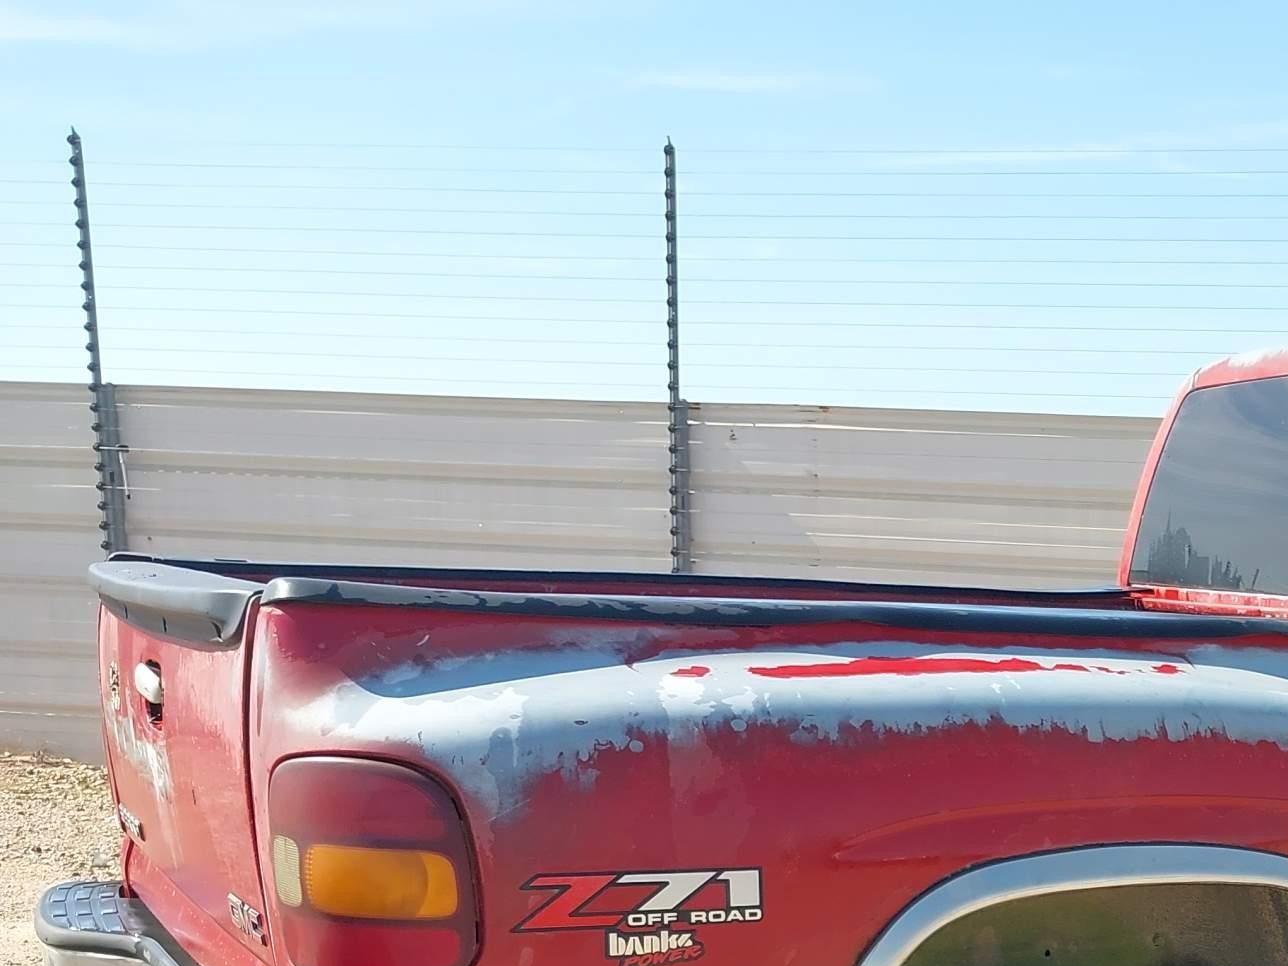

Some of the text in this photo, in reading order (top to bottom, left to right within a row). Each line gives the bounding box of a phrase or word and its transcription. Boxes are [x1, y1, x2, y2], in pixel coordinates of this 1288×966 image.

[227, 893, 267, 947] GMC
[512, 868, 761, 932] Z71
[627, 909, 762, 926] OFF ROAD
